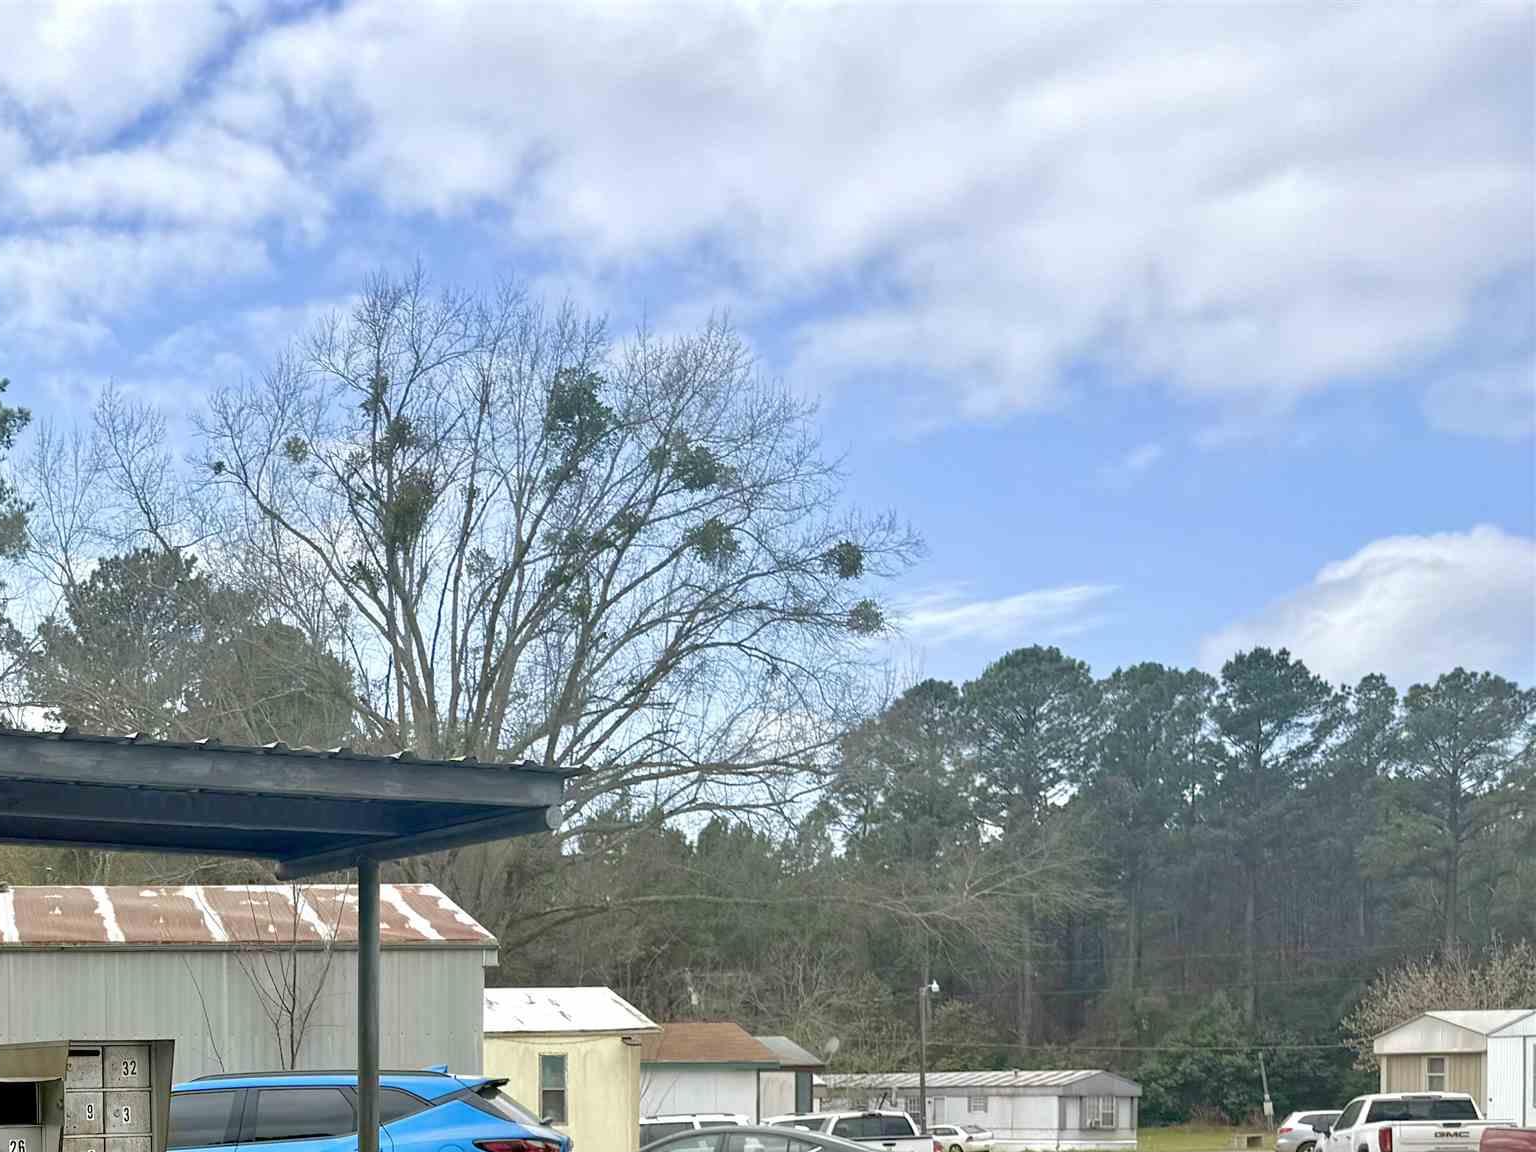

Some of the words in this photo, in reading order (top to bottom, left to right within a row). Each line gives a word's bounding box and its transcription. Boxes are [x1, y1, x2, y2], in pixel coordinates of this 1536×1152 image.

[122, 1060, 137, 1076] 32
[87, 1104, 94, 1120] 9
[123, 1107, 130, 1122] 3
